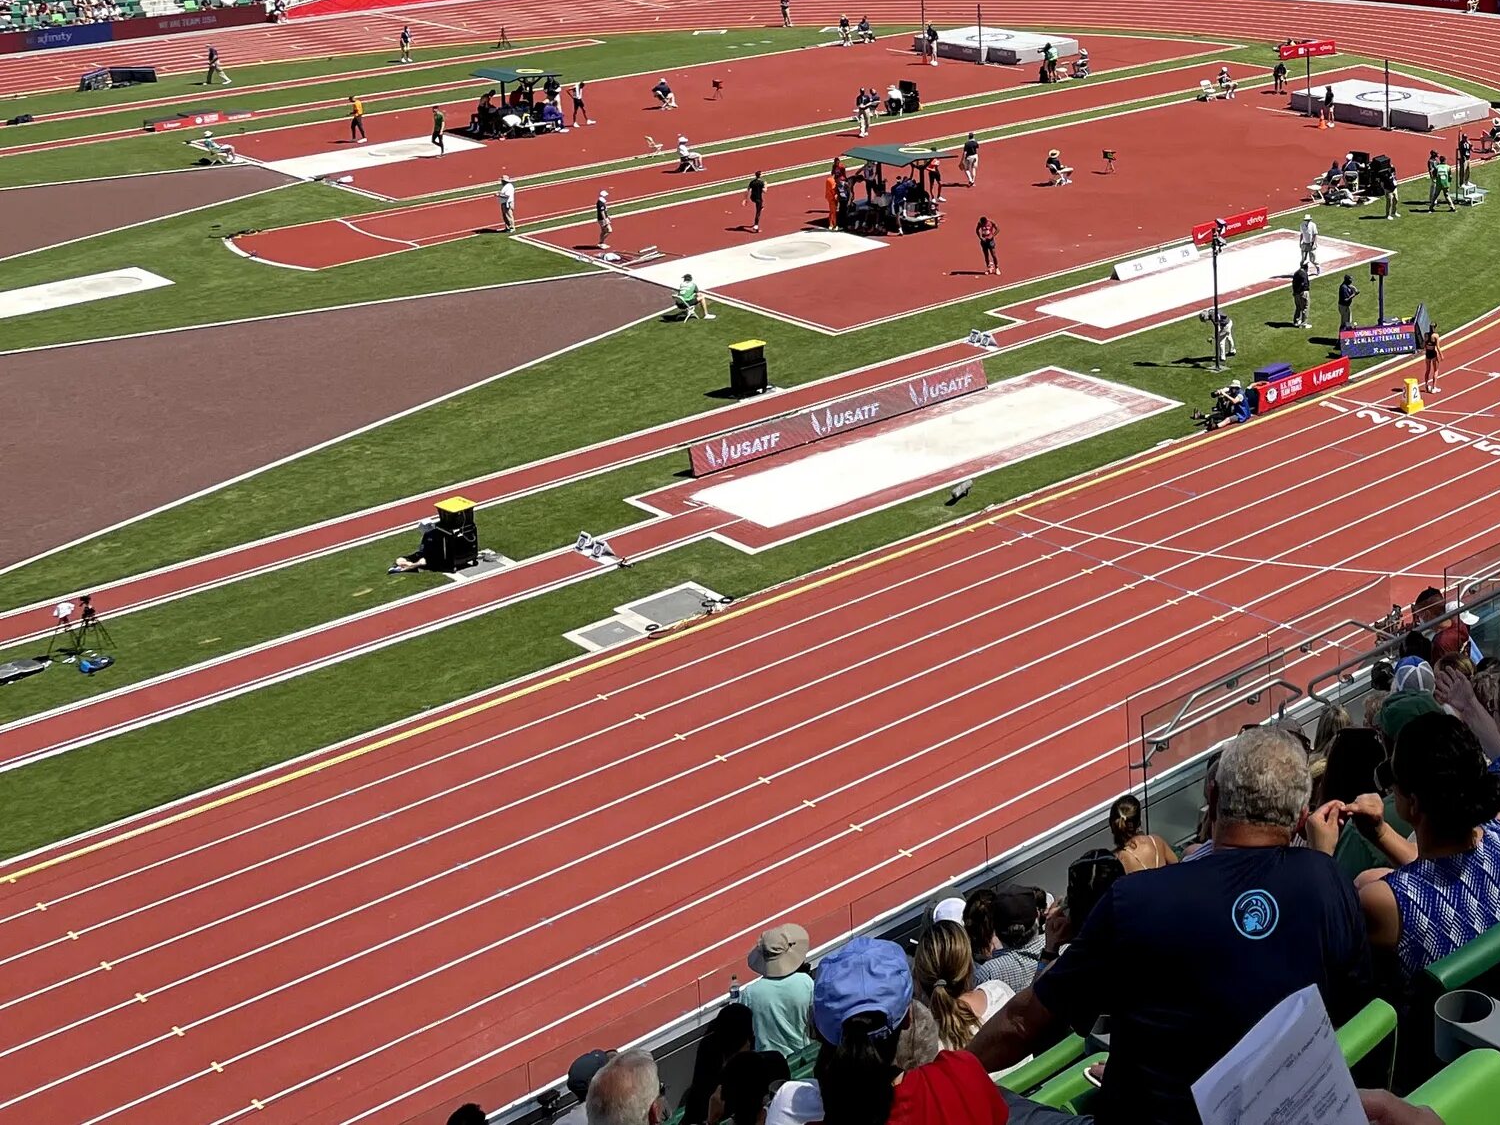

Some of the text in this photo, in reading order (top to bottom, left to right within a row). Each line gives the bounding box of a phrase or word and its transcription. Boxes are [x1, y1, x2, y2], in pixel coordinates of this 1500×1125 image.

[38, 32, 72, 44] xfinity
[1247, 215, 1264, 225] xfinity
[1323, 368, 1344, 381] USATF
[930, 374, 973, 398] USATF
[1413, 387, 1418, 398] 2
[833, 402, 880, 426] USATF
[1318, 401, 1349, 413] 1
[1356, 410, 1392, 424] 2
[1395, 420, 1427, 434] 3
[1440, 430, 1471, 444] 4
[731, 432, 780, 459] USATF
